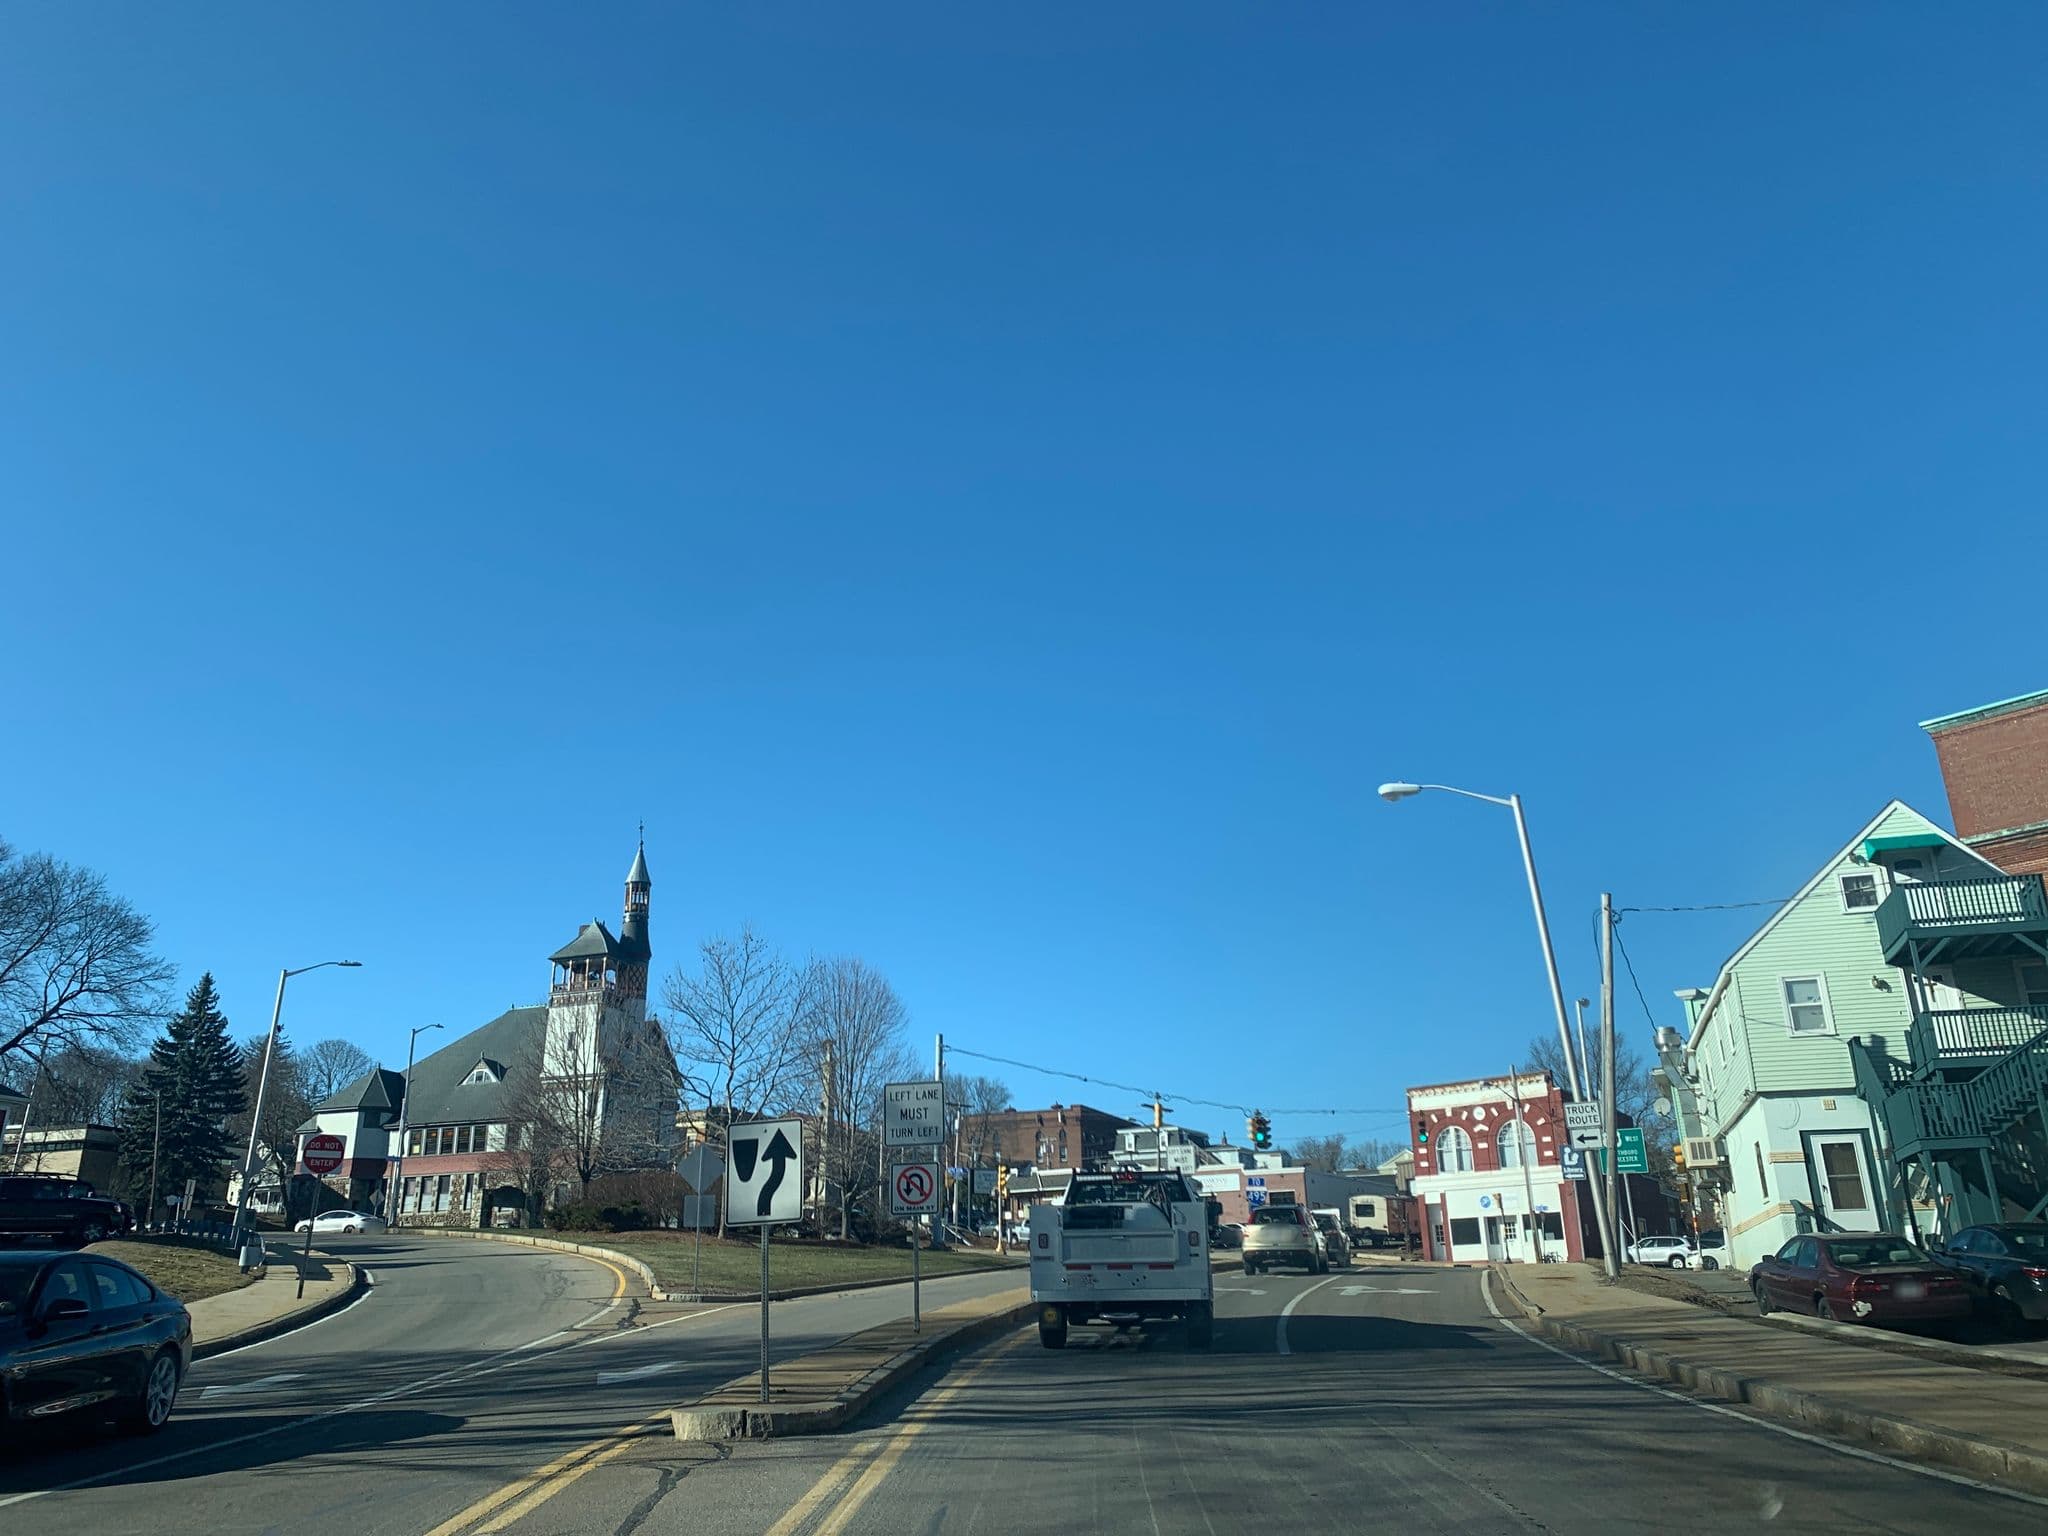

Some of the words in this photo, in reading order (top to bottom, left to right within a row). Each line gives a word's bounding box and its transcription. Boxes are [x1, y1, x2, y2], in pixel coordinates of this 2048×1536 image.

[889, 1090, 910, 1102] LEFT
[915, 1089, 939, 1101] LANE
[900, 1107, 928, 1121] MUST
[1566, 1104, 1597, 1115] TRUCK
[1569, 1114, 1599, 1125] ROUTE
[891, 1127, 913, 1138] TURN
[917, 1126, 939, 1137] LEFT
[310, 1141, 321, 1149] DO
[324, 1142, 340, 1150] NOT
[310, 1159, 335, 1167] ENTER
[1251, 1178, 1261, 1186] TO
[1247, 1191, 1266, 1202] 495
